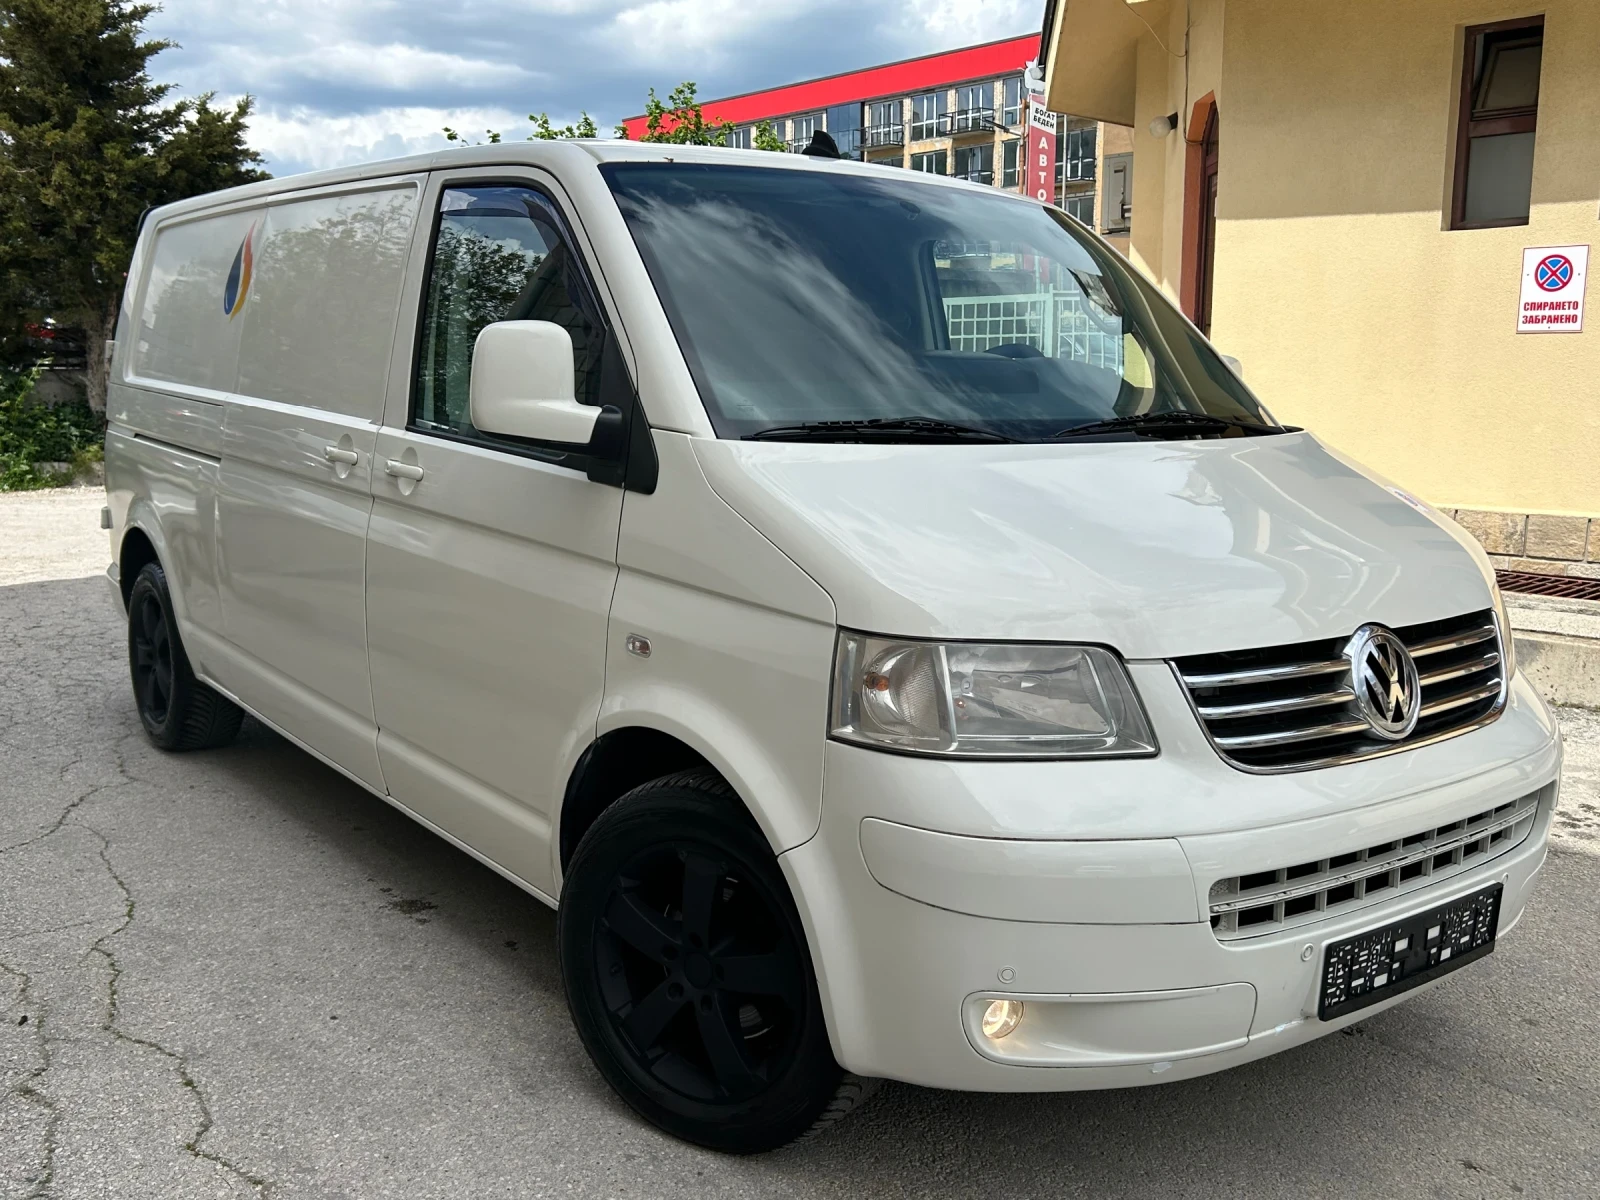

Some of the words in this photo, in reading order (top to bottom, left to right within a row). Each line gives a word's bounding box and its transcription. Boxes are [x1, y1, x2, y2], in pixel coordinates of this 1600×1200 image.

[1034, 107, 1055, 121] БОГАТ
[1033, 116, 1055, 129] БЕДЕН
[1037, 136, 1048, 202] АВТО
[1523, 300, 1579, 312] СПИРАНЕТО
[1522, 314, 1578, 325] ЗАБРАНЕНО
